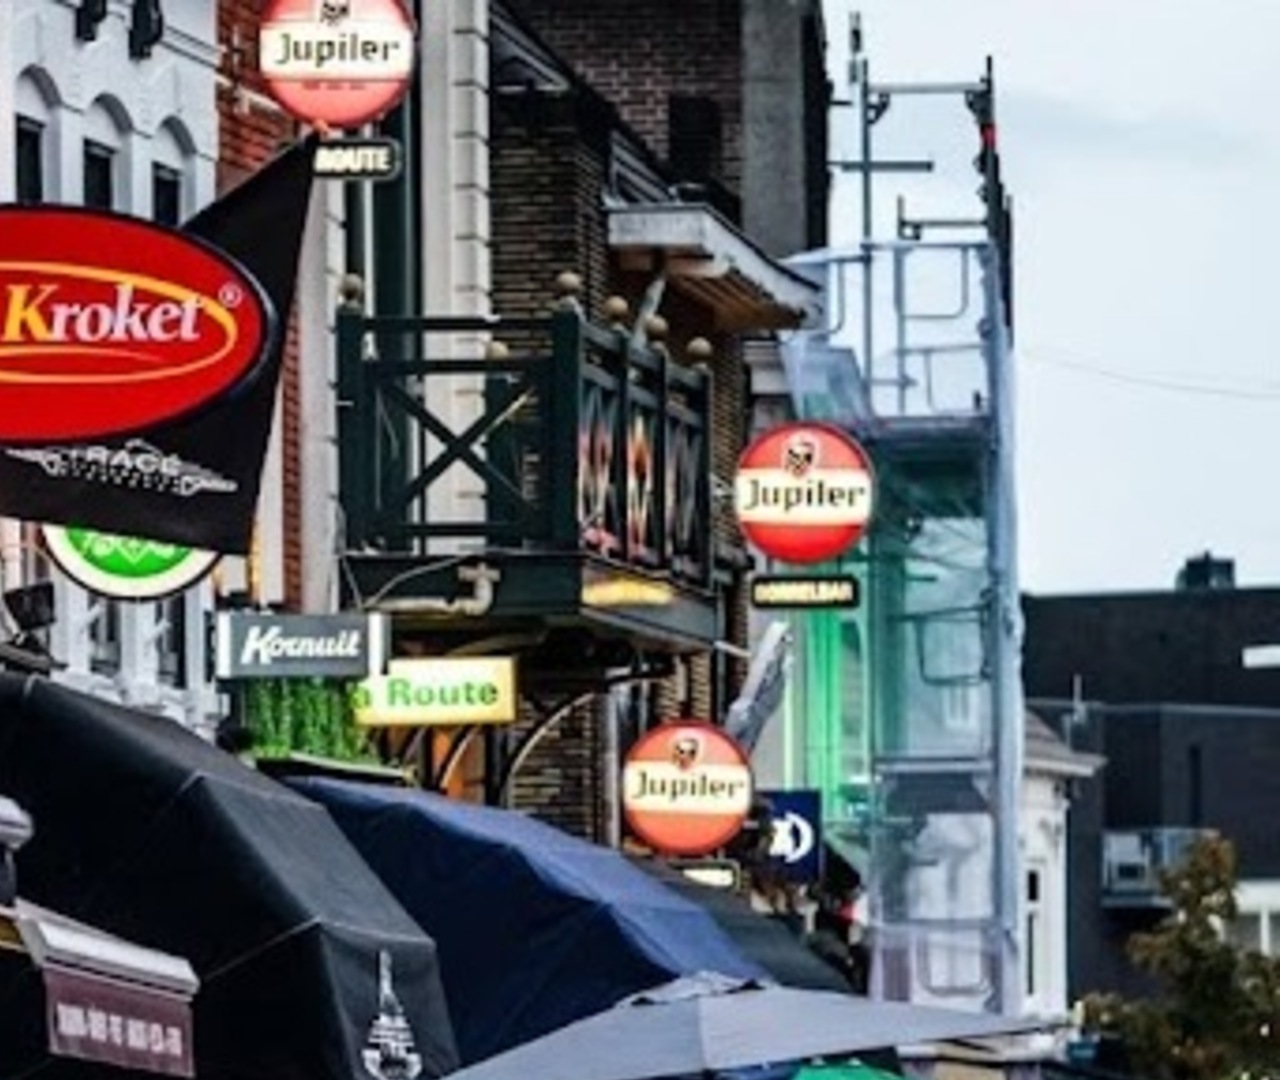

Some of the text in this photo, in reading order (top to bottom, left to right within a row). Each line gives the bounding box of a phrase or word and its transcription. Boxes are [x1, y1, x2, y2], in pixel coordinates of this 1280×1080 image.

[274, 33, 400, 68] Jupiler
[314, 146, 391, 173] ROUTE
[0, 283, 206, 343] Kroket
[743, 479, 865, 511] Jupiler
[241, 626, 362, 664] Kornuit
[387, 678, 499, 707] Route
[632, 770, 745, 801] Jupiler
